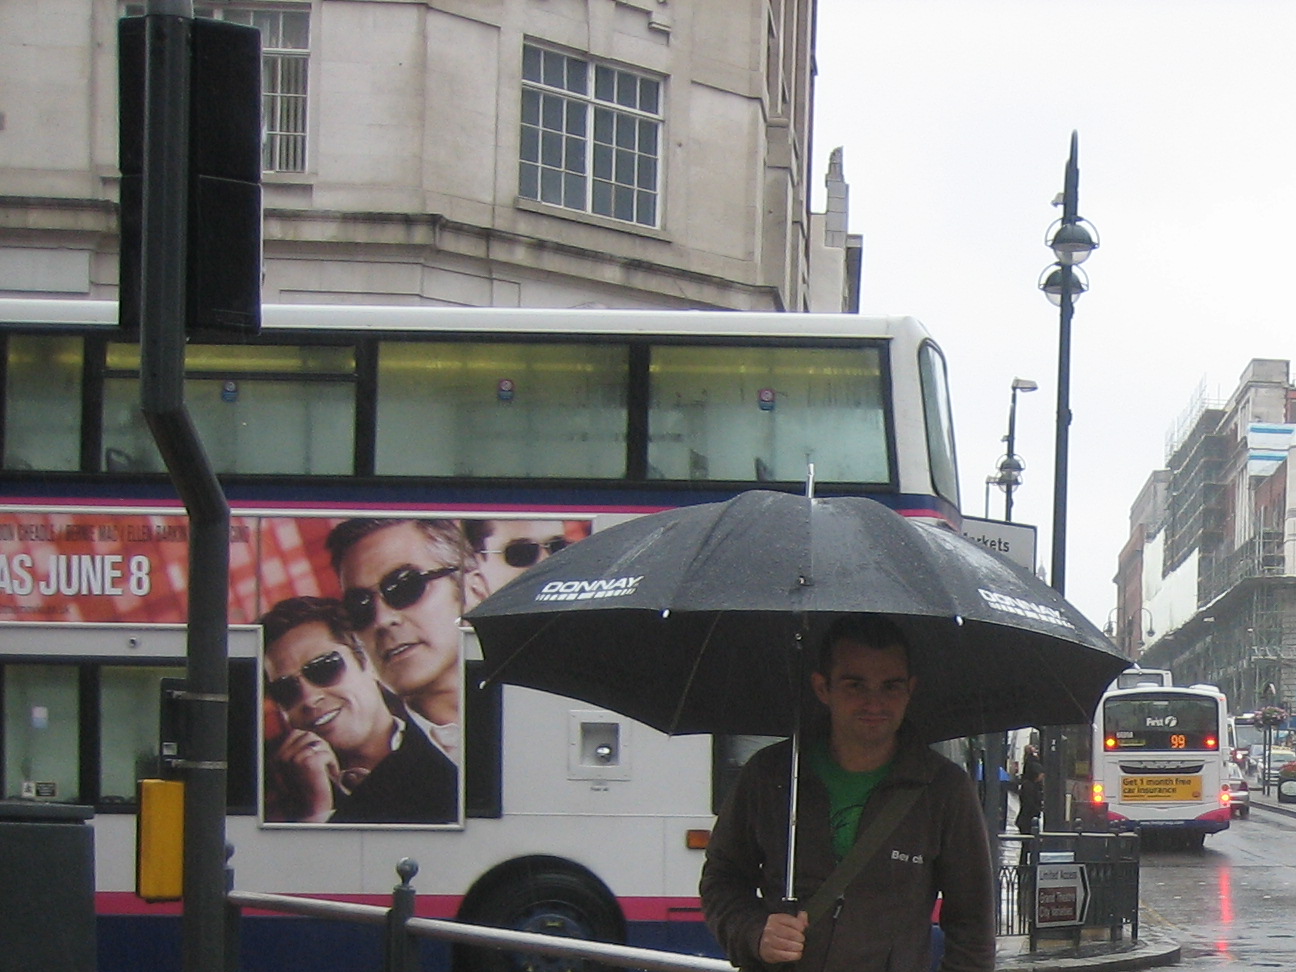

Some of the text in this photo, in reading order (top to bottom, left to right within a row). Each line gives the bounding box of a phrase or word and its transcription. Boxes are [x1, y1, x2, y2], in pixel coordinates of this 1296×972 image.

[39, 554, 123, 596] JUNE
[129, 555, 150, 596] 8
[541, 576, 645, 593] DONNAY
[1146, 717, 1165, 727] First
[1170, 734, 1187, 749] 99
[1122, 778, 1138, 786] Get
[1146, 778, 1175, 786] month
[1175, 778, 1192, 786] free
[1137, 786, 1177, 794] insurance
